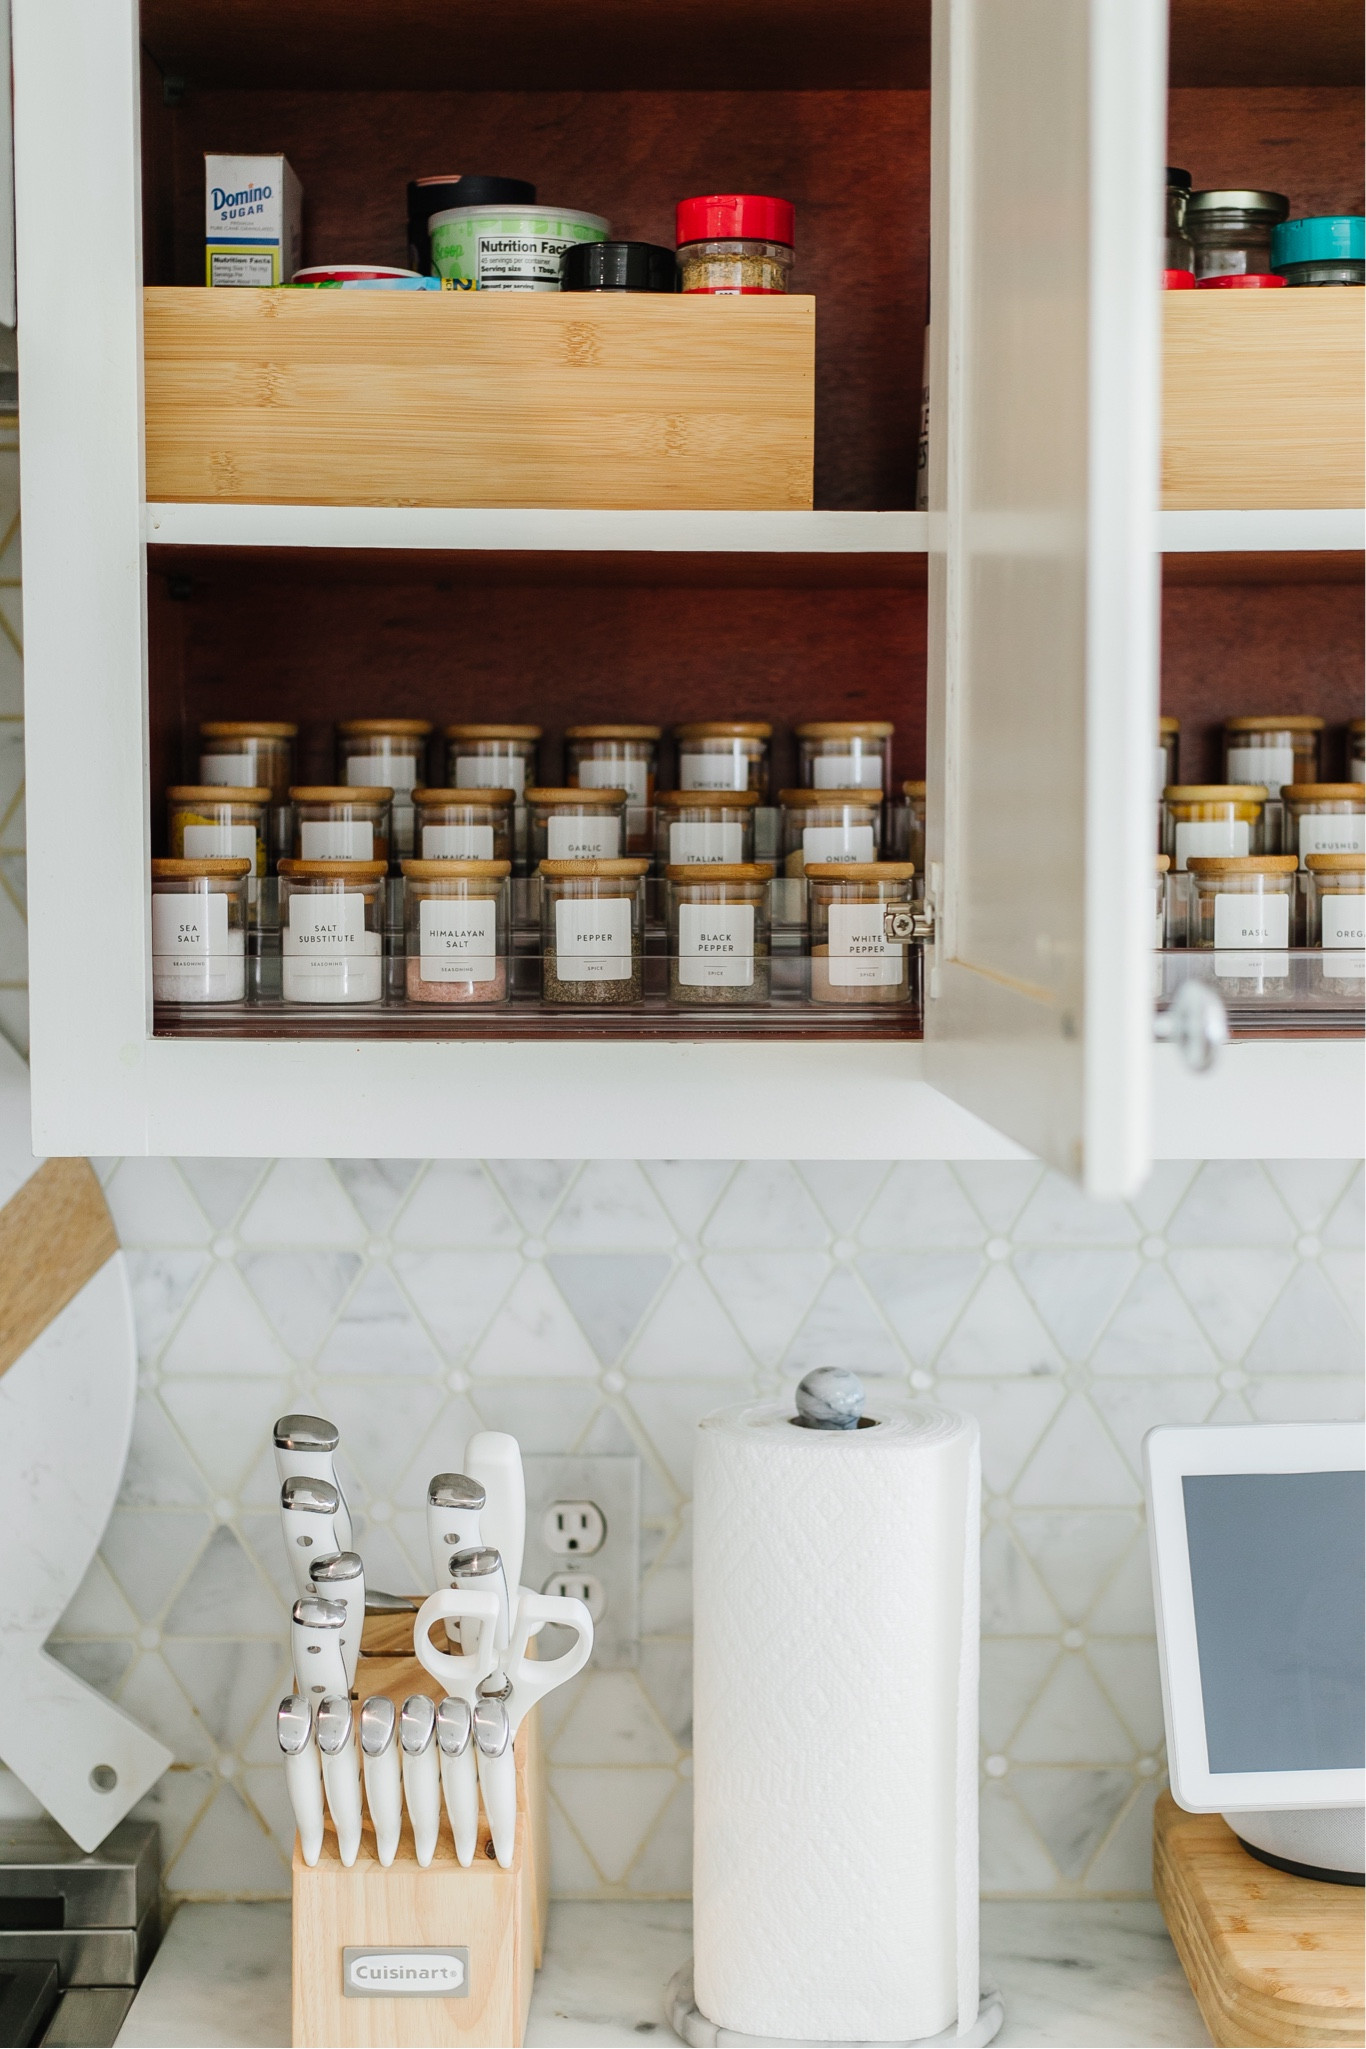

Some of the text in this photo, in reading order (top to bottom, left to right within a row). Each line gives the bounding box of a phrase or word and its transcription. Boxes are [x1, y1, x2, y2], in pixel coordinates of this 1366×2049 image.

[211, 183, 272, 210] Domino
[221, 204, 263, 221] SUGAR
[481, 240, 569, 255] Nutrition Fact
[481, 265, 506, 273] Serving
[508, 264, 521, 272] size
[568, 844, 602, 852] GARLIC
[179, 924, 198, 932] SEA
[314, 924, 337, 932] SALT
[576, 934, 613, 942] PEPPER
[700, 933, 732, 941] BLACK
[1336, 930, 1366, 938] OREG
[299, 935, 355, 943] SUBSTITUTE
[851, 935, 883, 943] WHITE
[446, 940, 469, 948] SALT
[698, 944, 734, 952] PEPPER
[849, 945, 885, 953] PEPPER
[356, 1965, 448, 1979] Cuisinart
